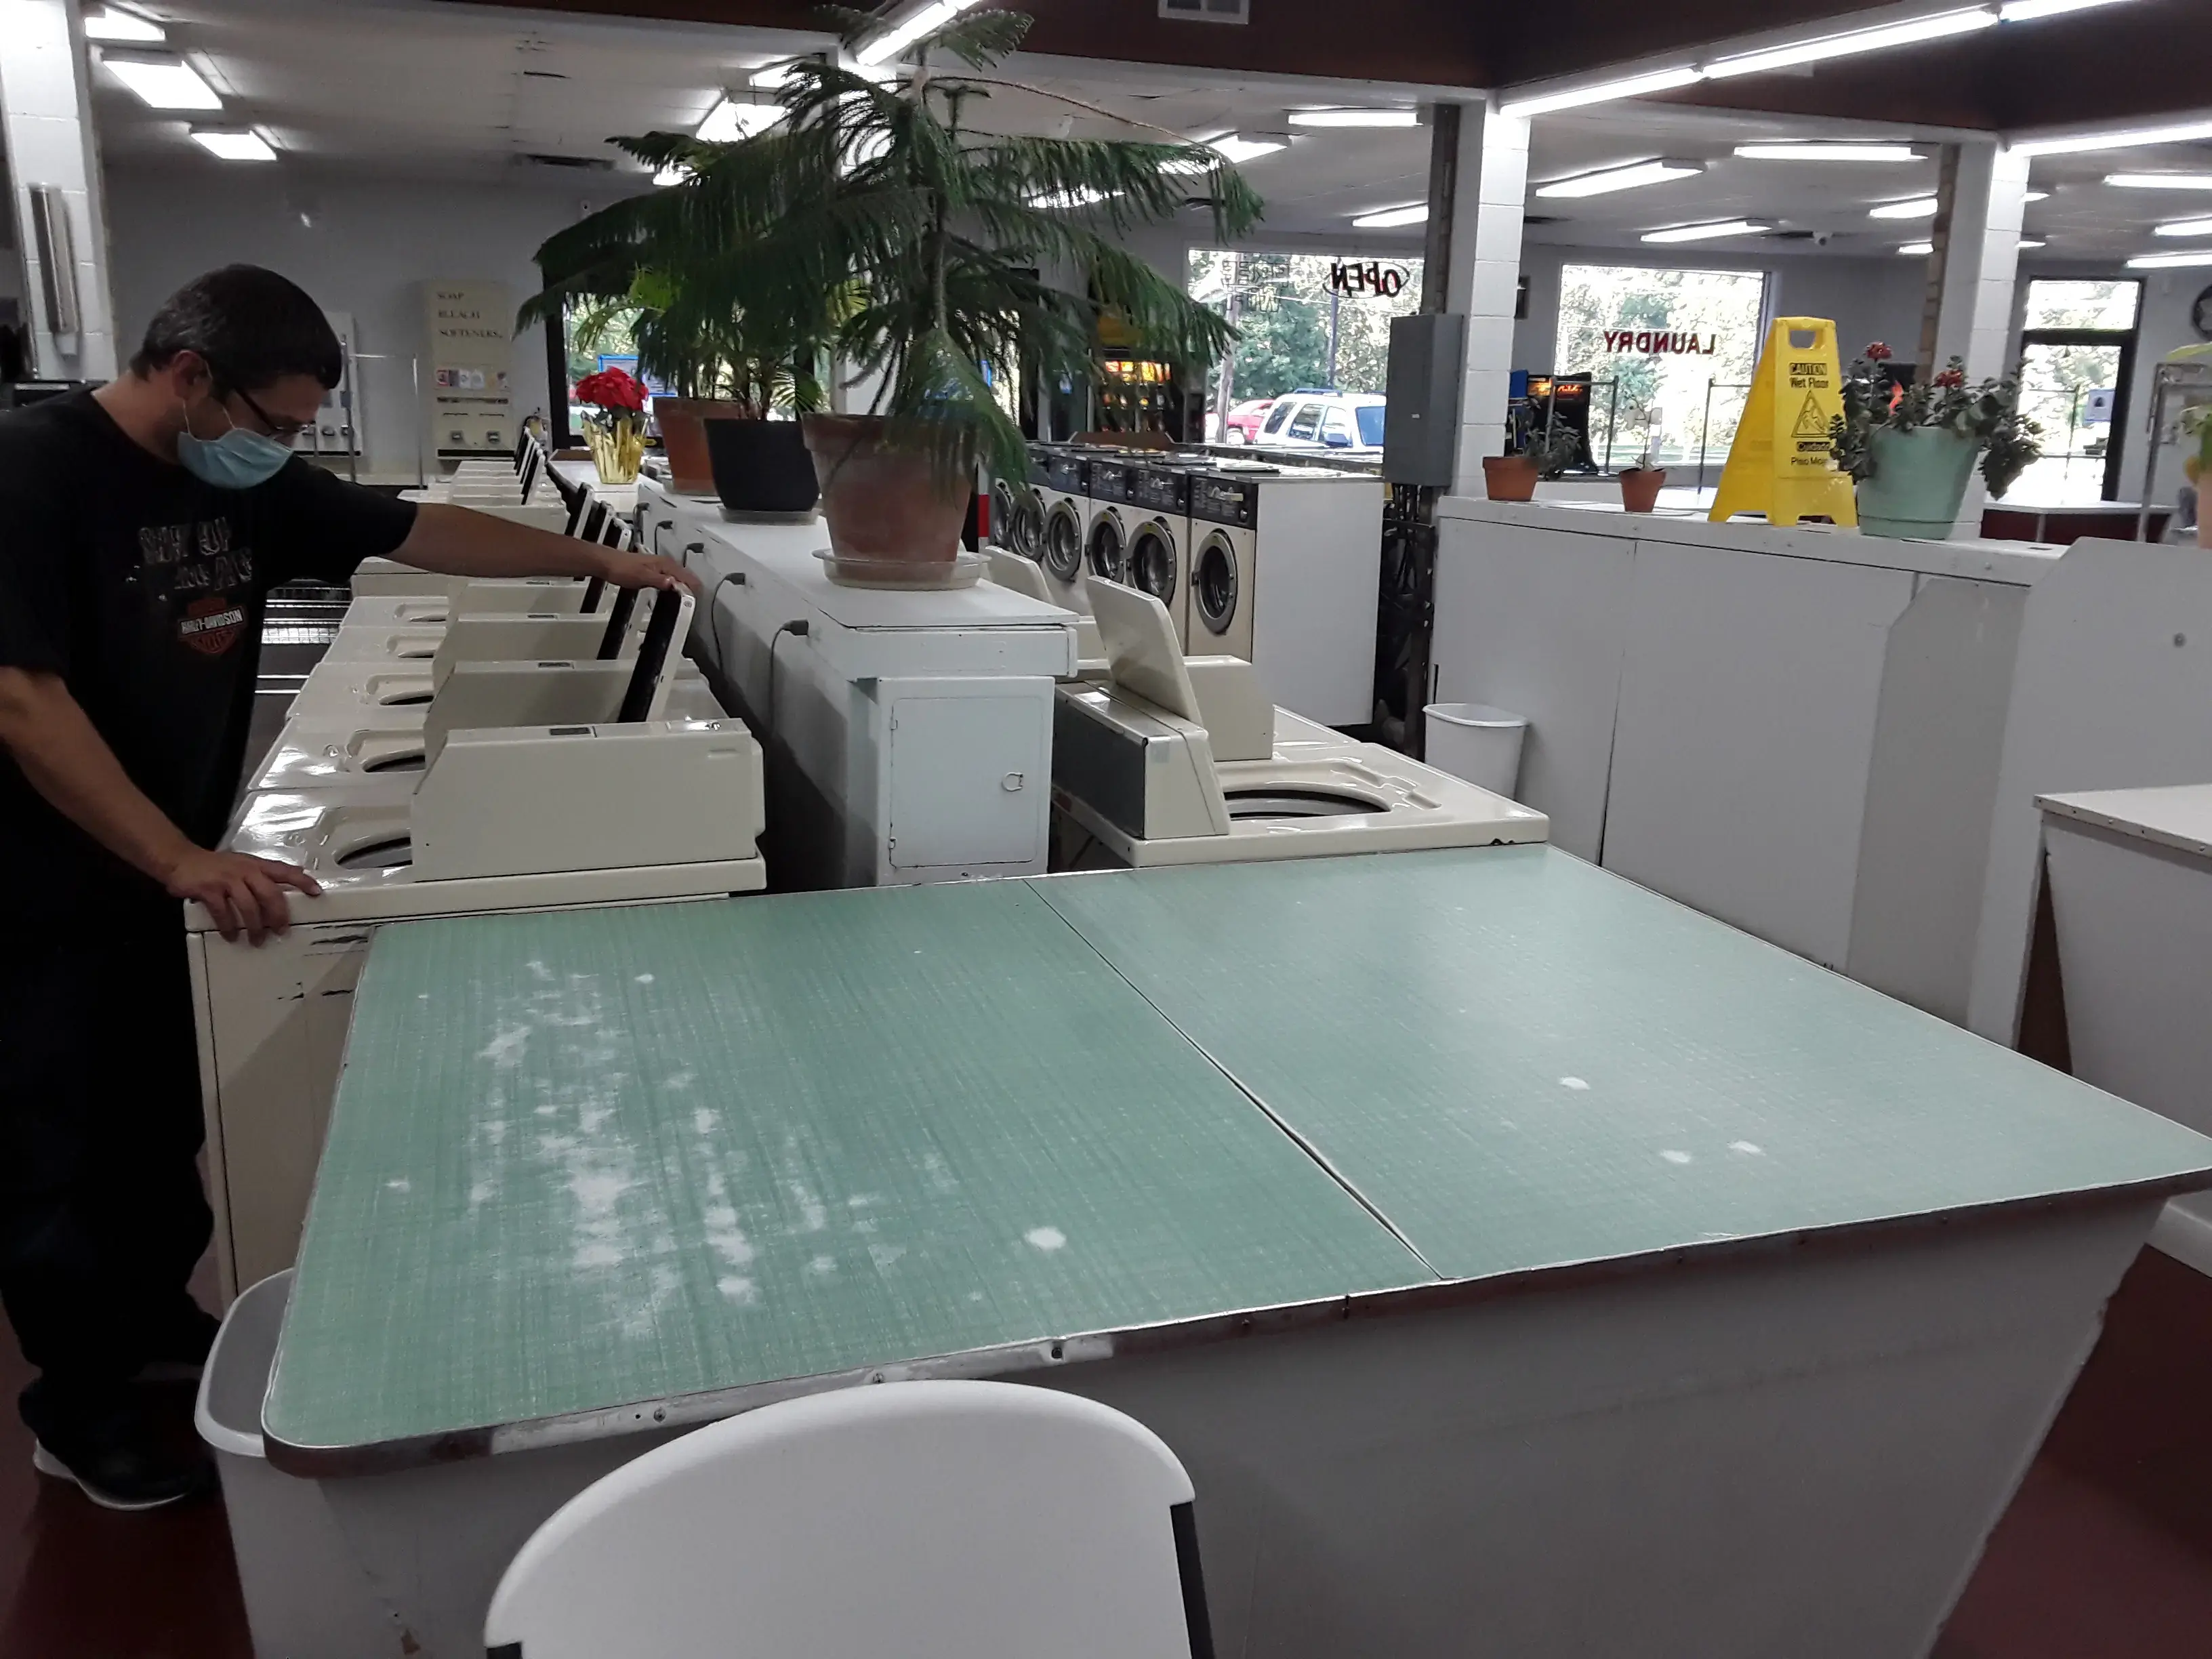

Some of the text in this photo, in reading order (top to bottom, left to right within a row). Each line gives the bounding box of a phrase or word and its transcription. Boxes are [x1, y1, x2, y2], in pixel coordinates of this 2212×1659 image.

[437, 291, 465, 300] SOAP
[1790, 363, 1828, 375] CAUTION
[1789, 377, 1830, 388] Wet Floor
